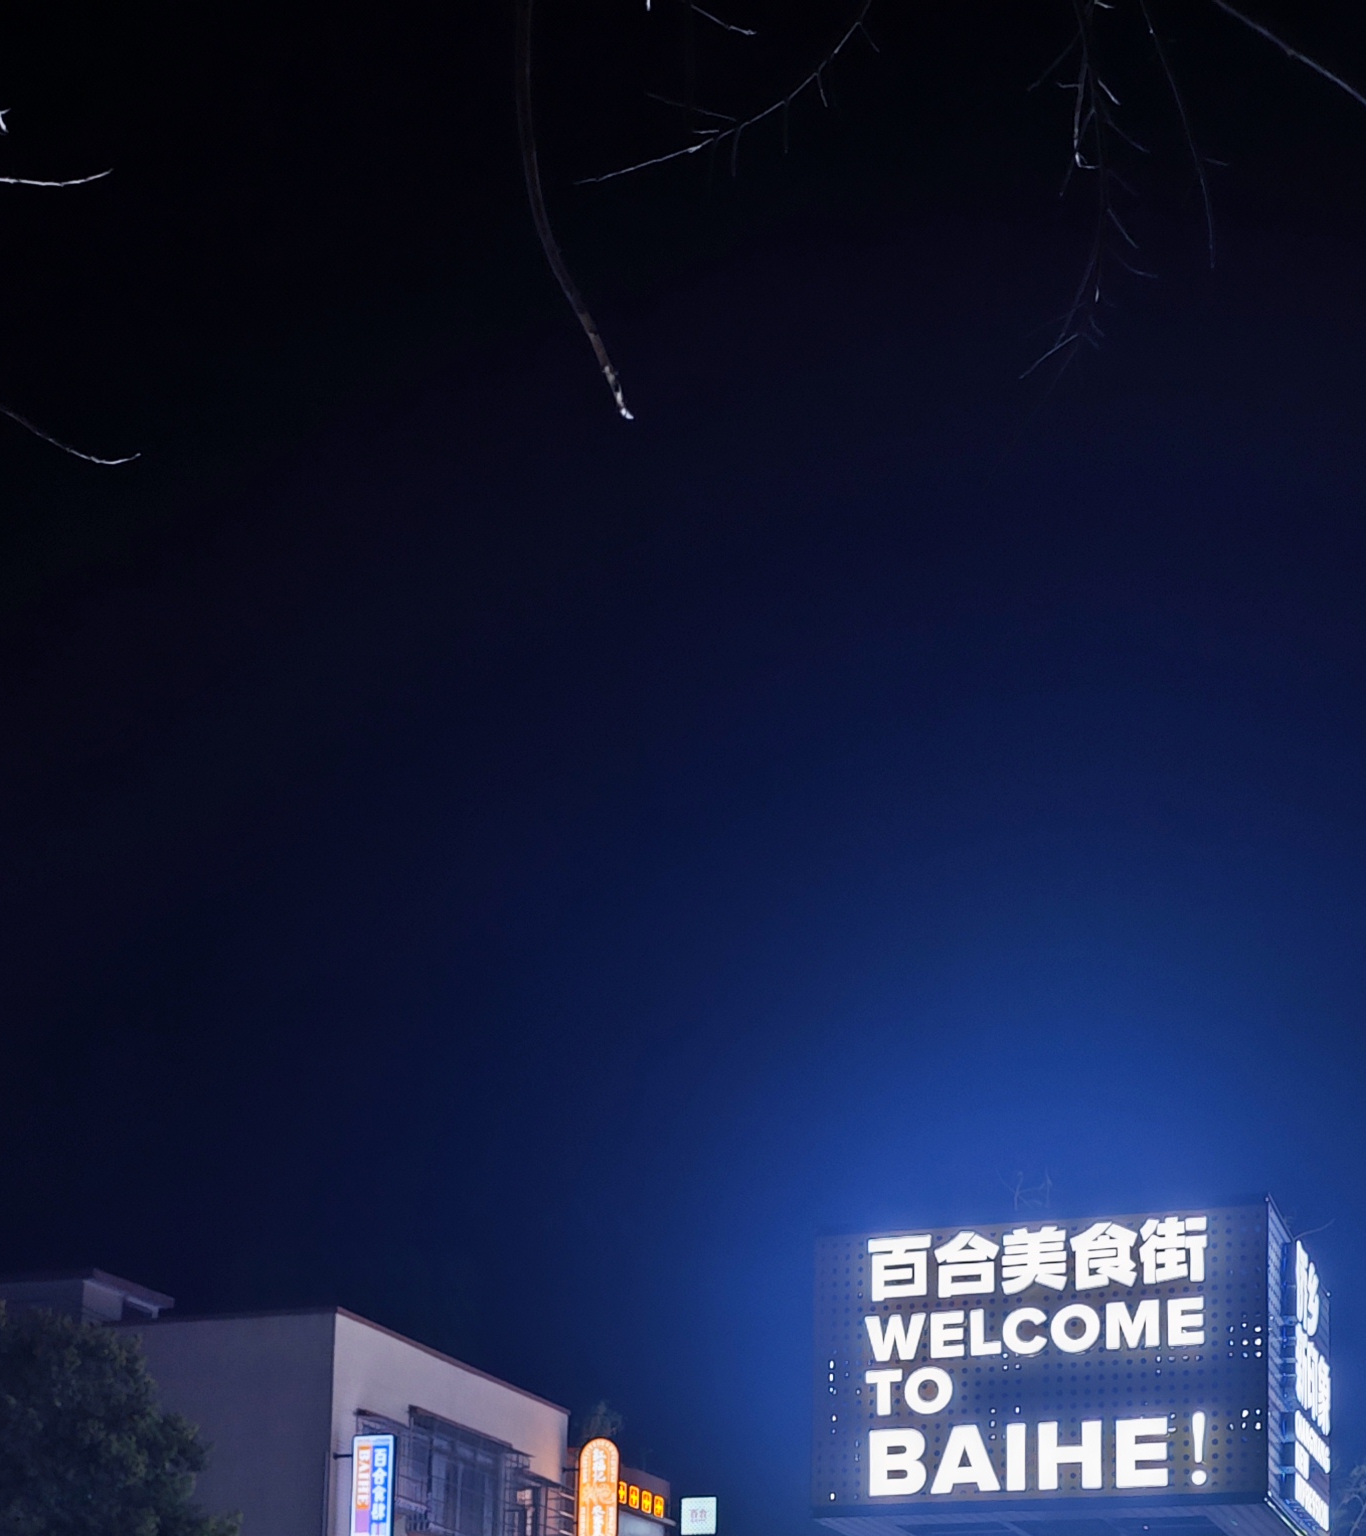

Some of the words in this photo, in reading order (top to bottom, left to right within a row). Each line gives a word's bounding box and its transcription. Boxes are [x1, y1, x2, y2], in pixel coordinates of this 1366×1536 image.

[867, 1216, 1208, 1301] 百合美食街
[866, 1298, 1206, 1362] WELCOME
[866, 1366, 953, 1417] TO
